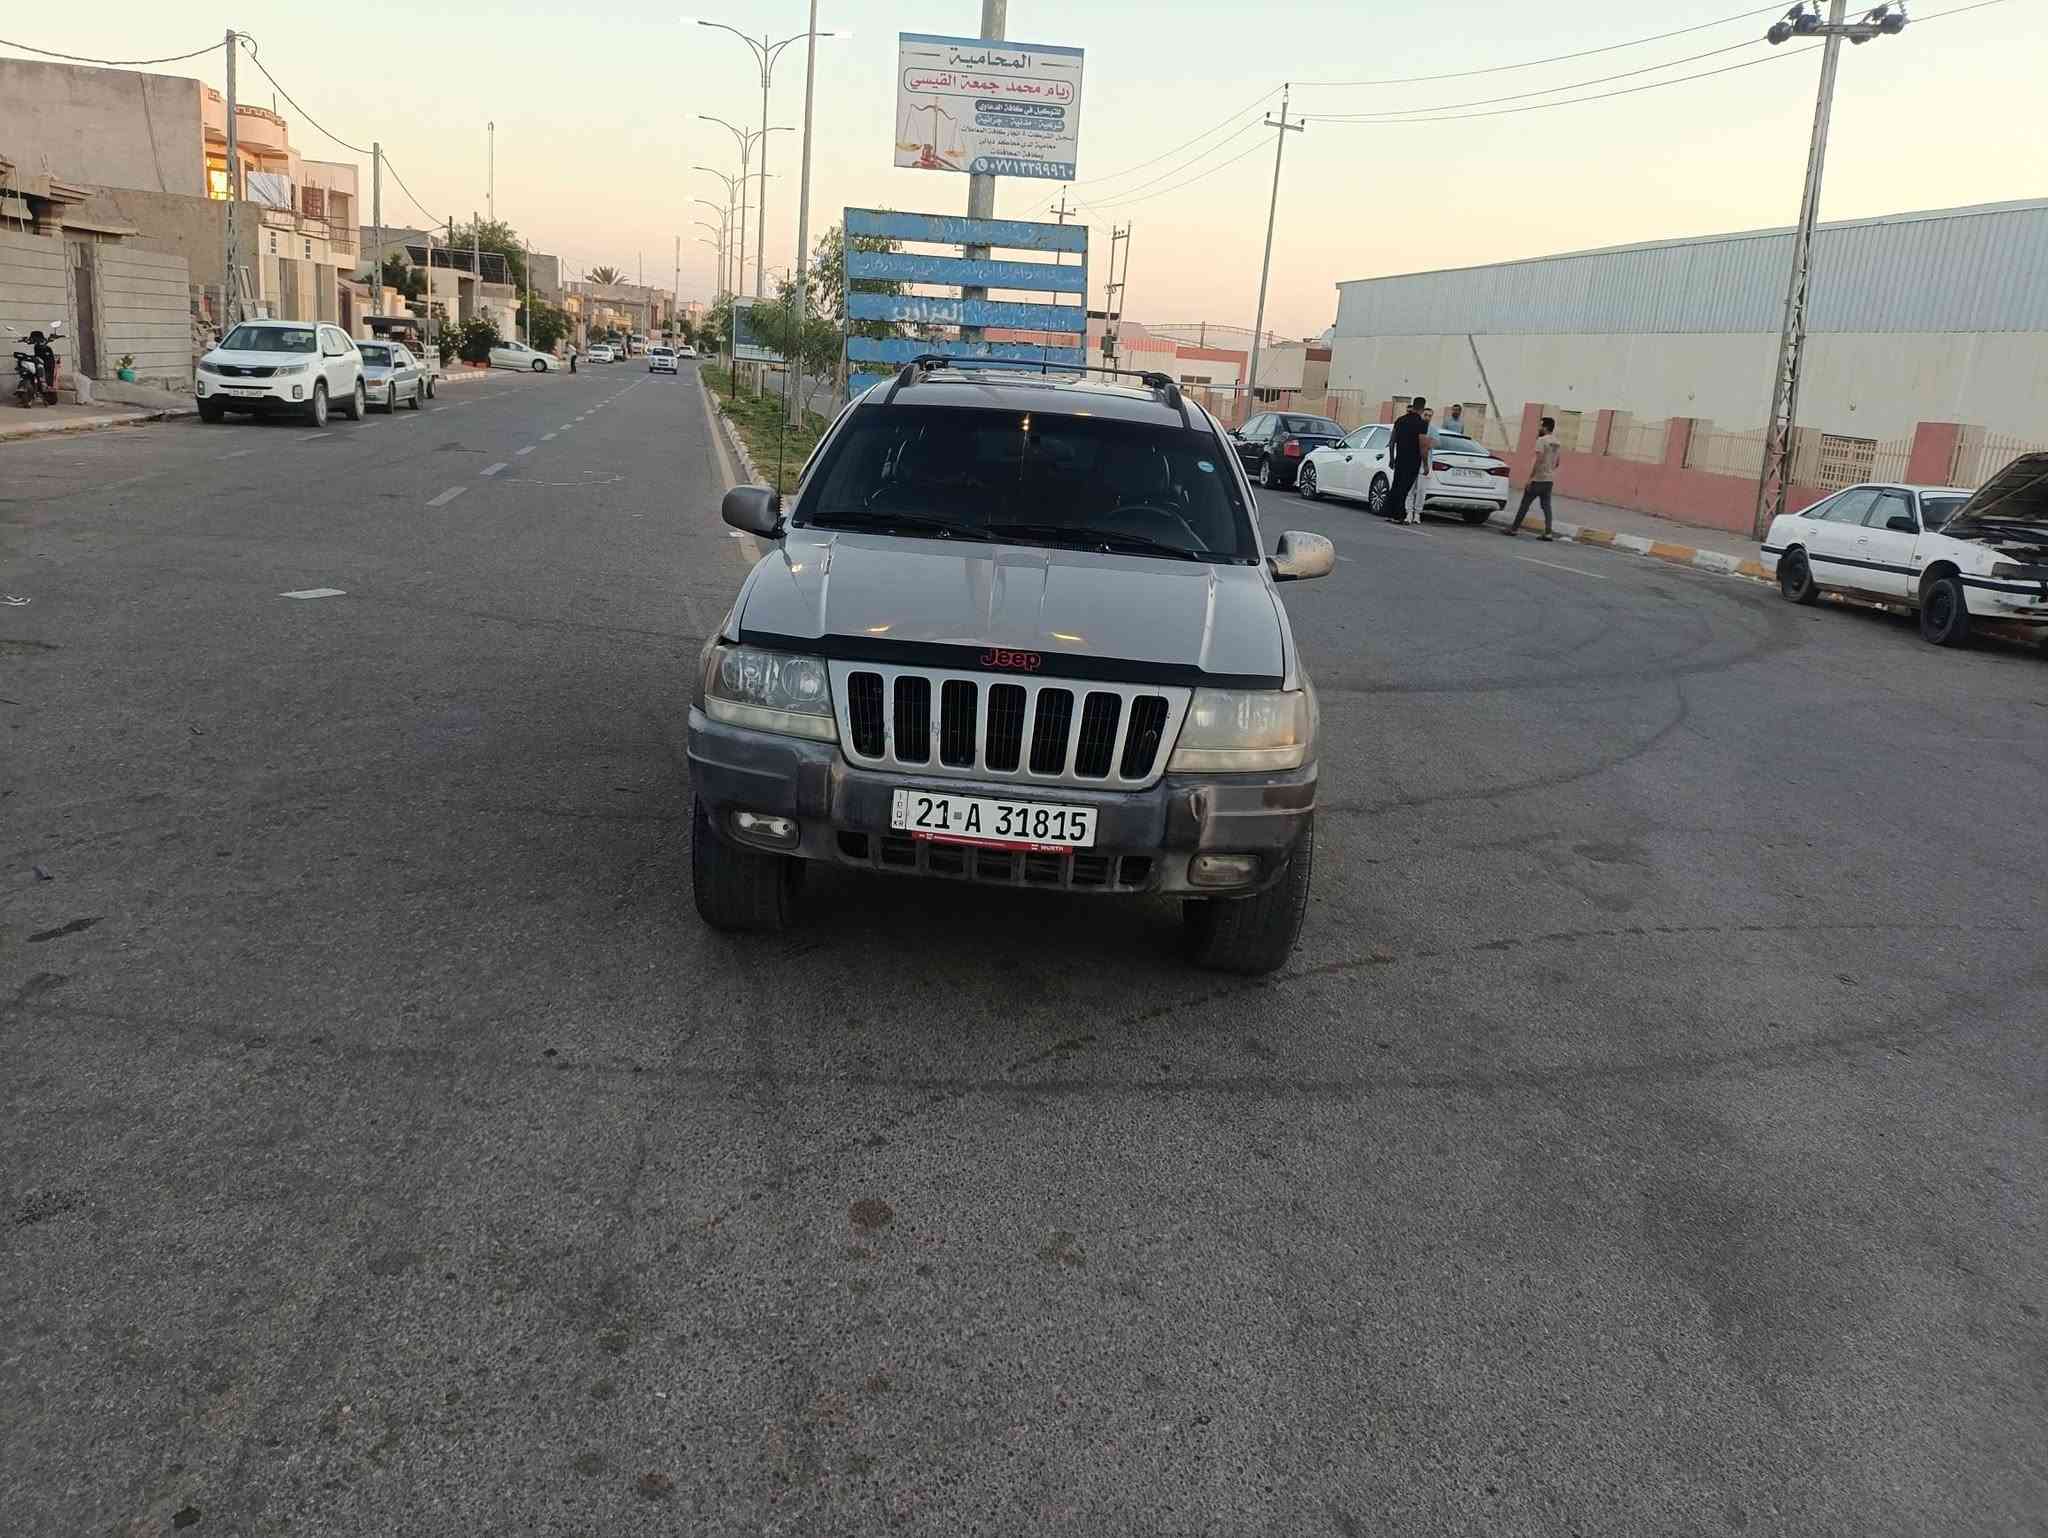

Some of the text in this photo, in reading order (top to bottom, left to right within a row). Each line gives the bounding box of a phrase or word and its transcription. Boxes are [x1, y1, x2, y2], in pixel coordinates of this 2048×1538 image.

[949, 47, 1032, 69] المحامية
[909, 72, 957, 90] القيسي
[960, 75, 1000, 92] جمعة
[1006, 82, 1041, 94] محمد
[981, 648, 1041, 672] Jeep
[916, 797, 1088, 841] 21 A 31815
